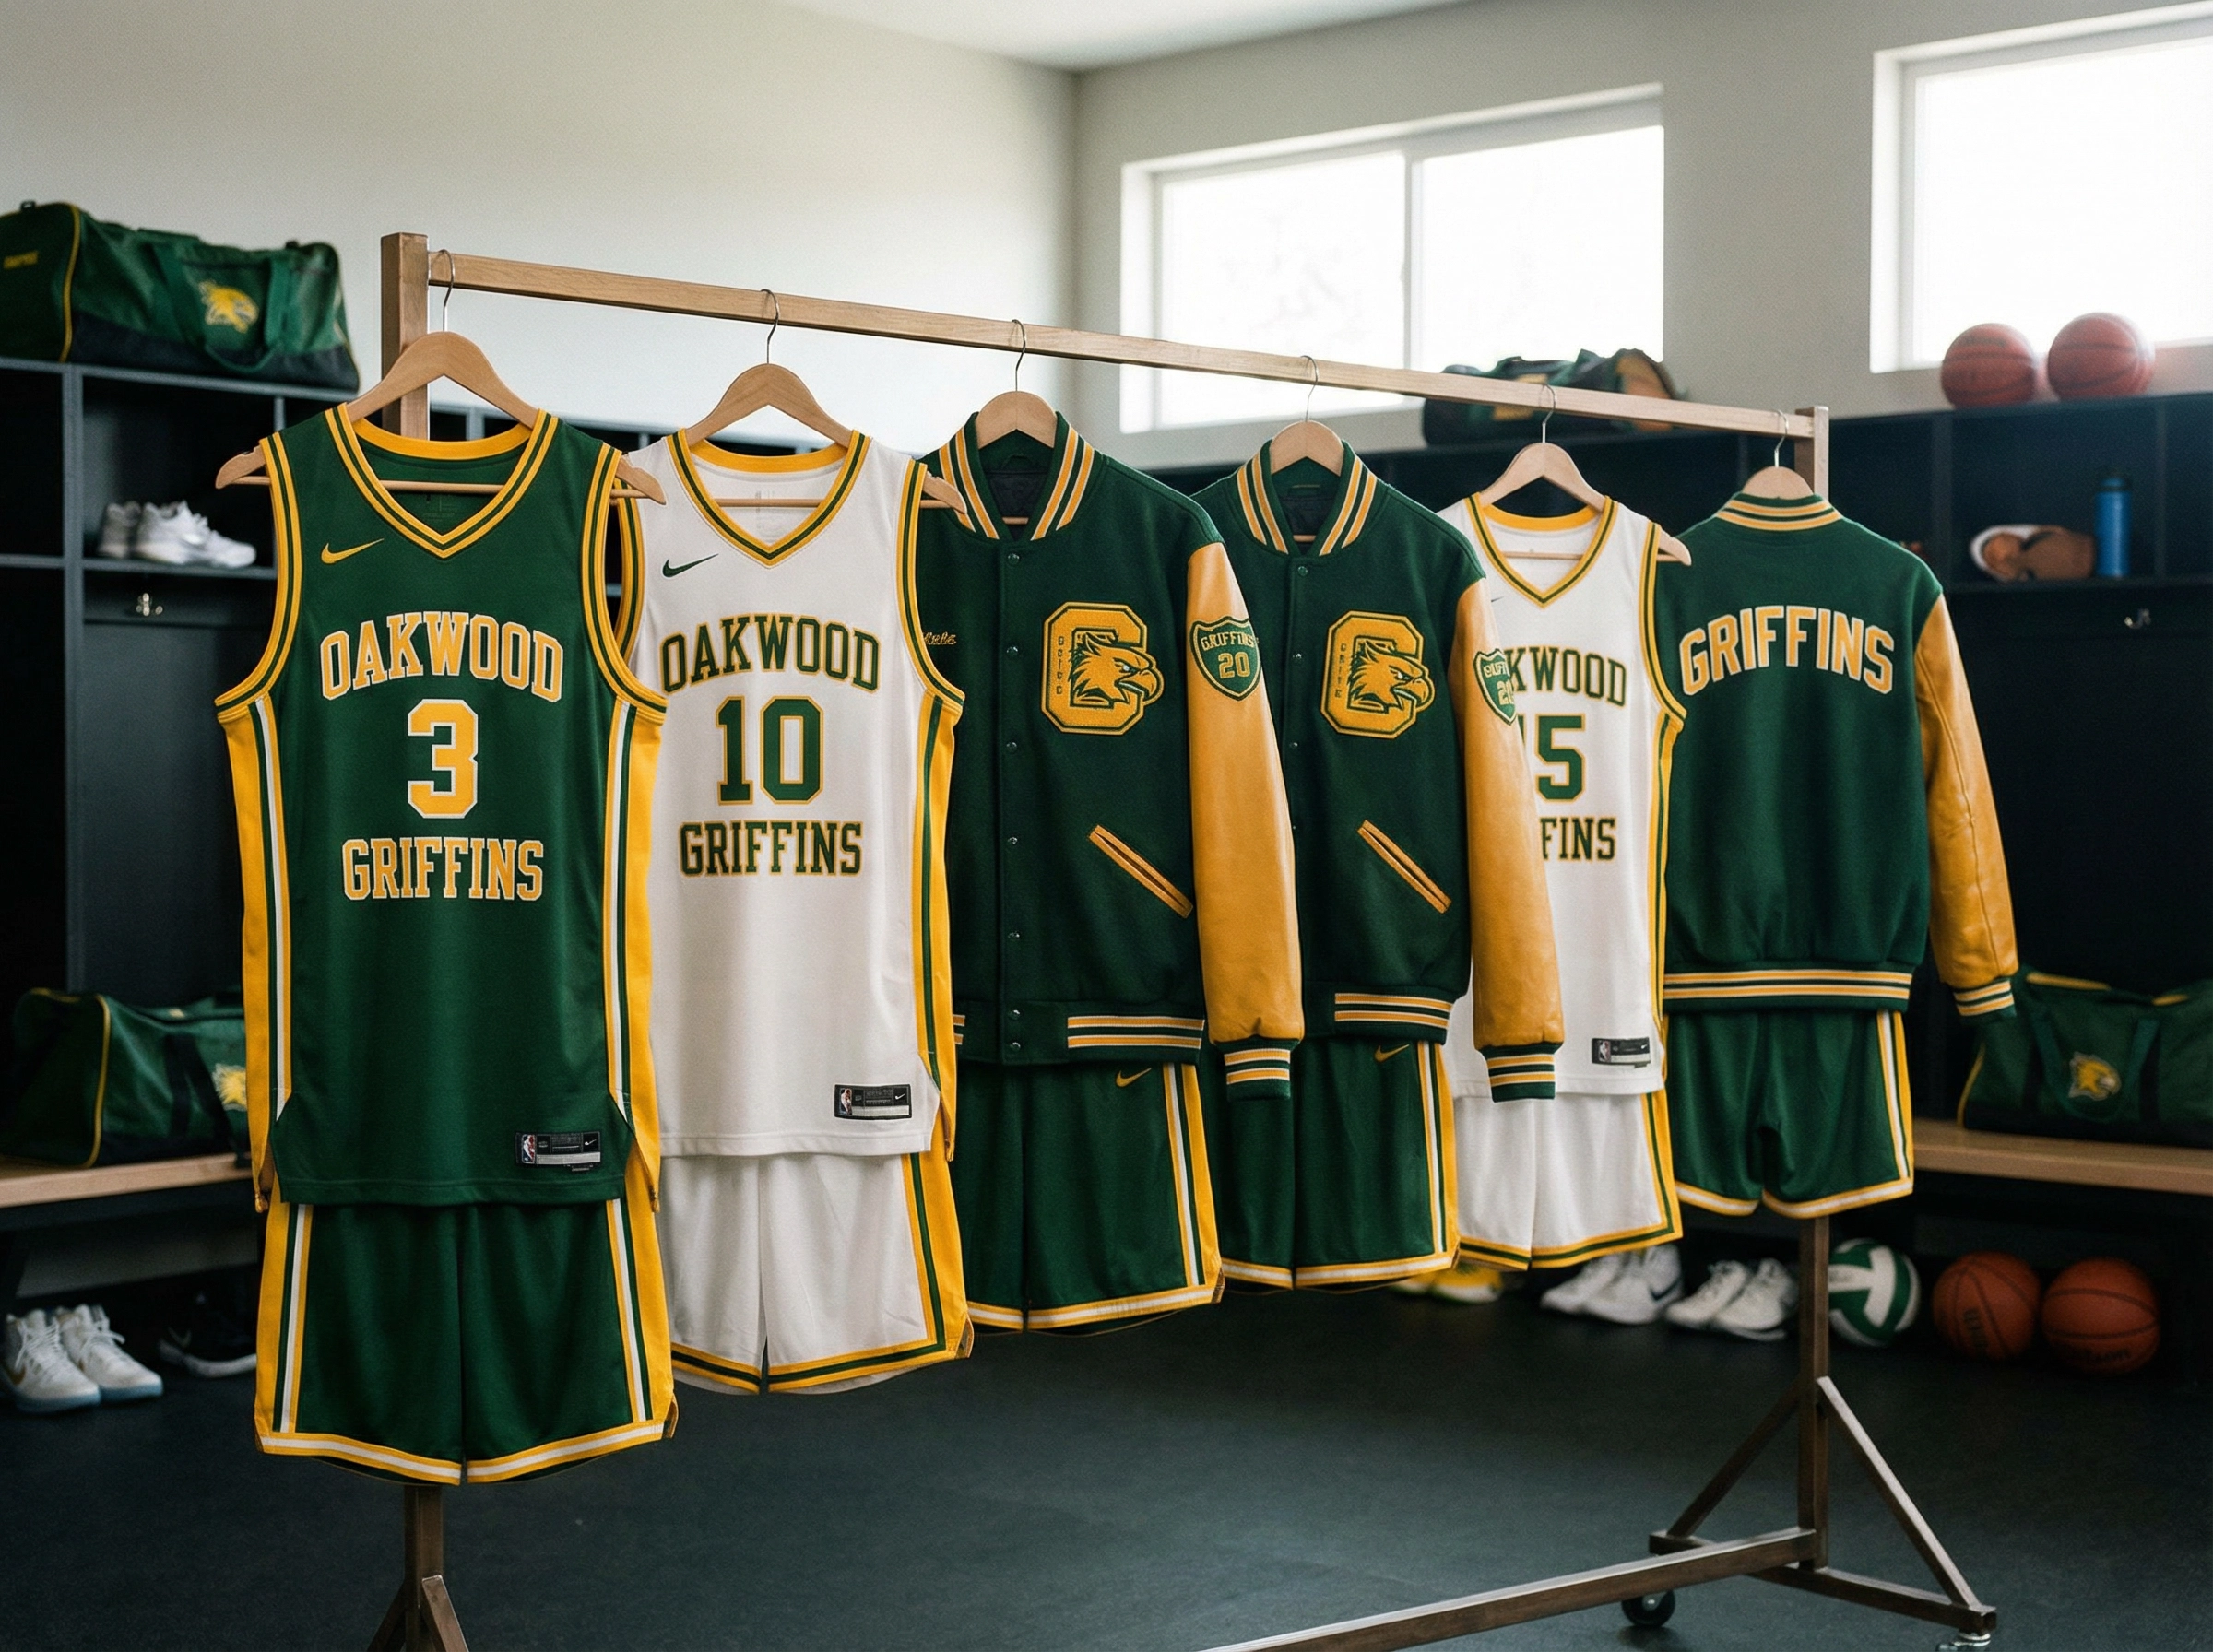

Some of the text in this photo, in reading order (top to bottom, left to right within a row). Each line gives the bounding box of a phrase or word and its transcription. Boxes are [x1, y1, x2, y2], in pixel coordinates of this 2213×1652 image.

[320, 610, 564, 703] OAKWOOD
[659, 612, 882, 695] OAKWOOD
[1218, 651, 1251, 679] 20
[1505, 645, 1628, 709] KWOOD
[1679, 605, 1895, 696] GRIFFINS
[408, 698, 479, 819] 3
[715, 695, 824, 807] 10
[1516, 712, 1586, 804] 5
[342, 835, 544, 902] GRIFFINS
[678, 819, 864, 878] GRIFFINS
